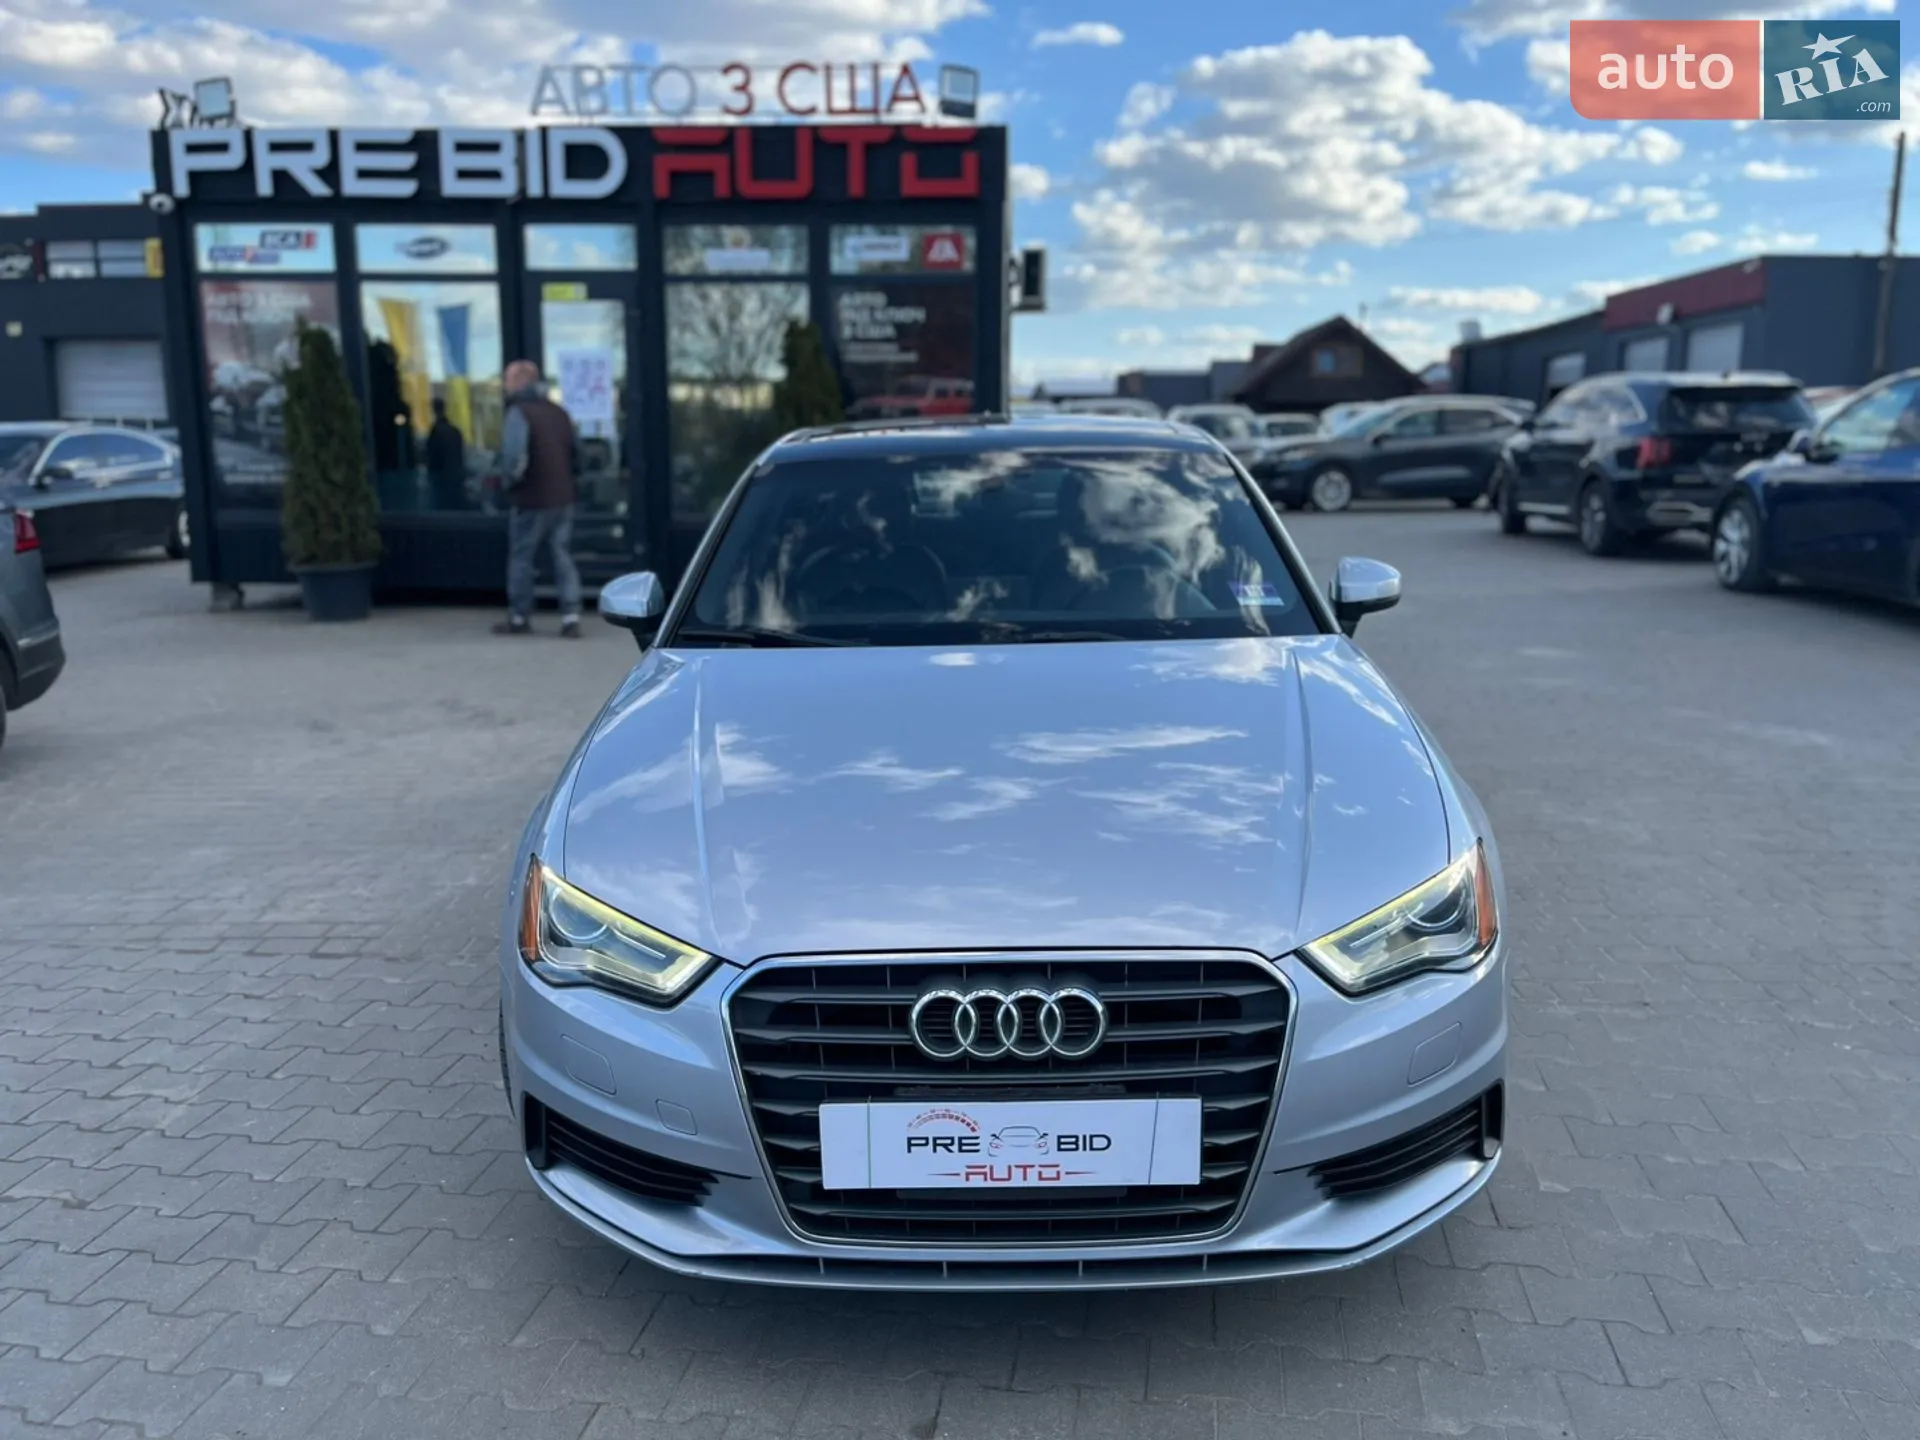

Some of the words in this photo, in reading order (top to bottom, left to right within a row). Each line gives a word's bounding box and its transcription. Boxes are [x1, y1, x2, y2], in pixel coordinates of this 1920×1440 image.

[531, 64, 698, 116] АВТО
[777, 62, 927, 116] США
[169, 127, 420, 198] PRE
[438, 127, 628, 199] BID
[652, 127, 980, 199] AUTO
[906, 1135, 981, 1154] PRE
[1056, 1133, 1112, 1152] BID
[965, 1164, 1061, 1182] AUTO
